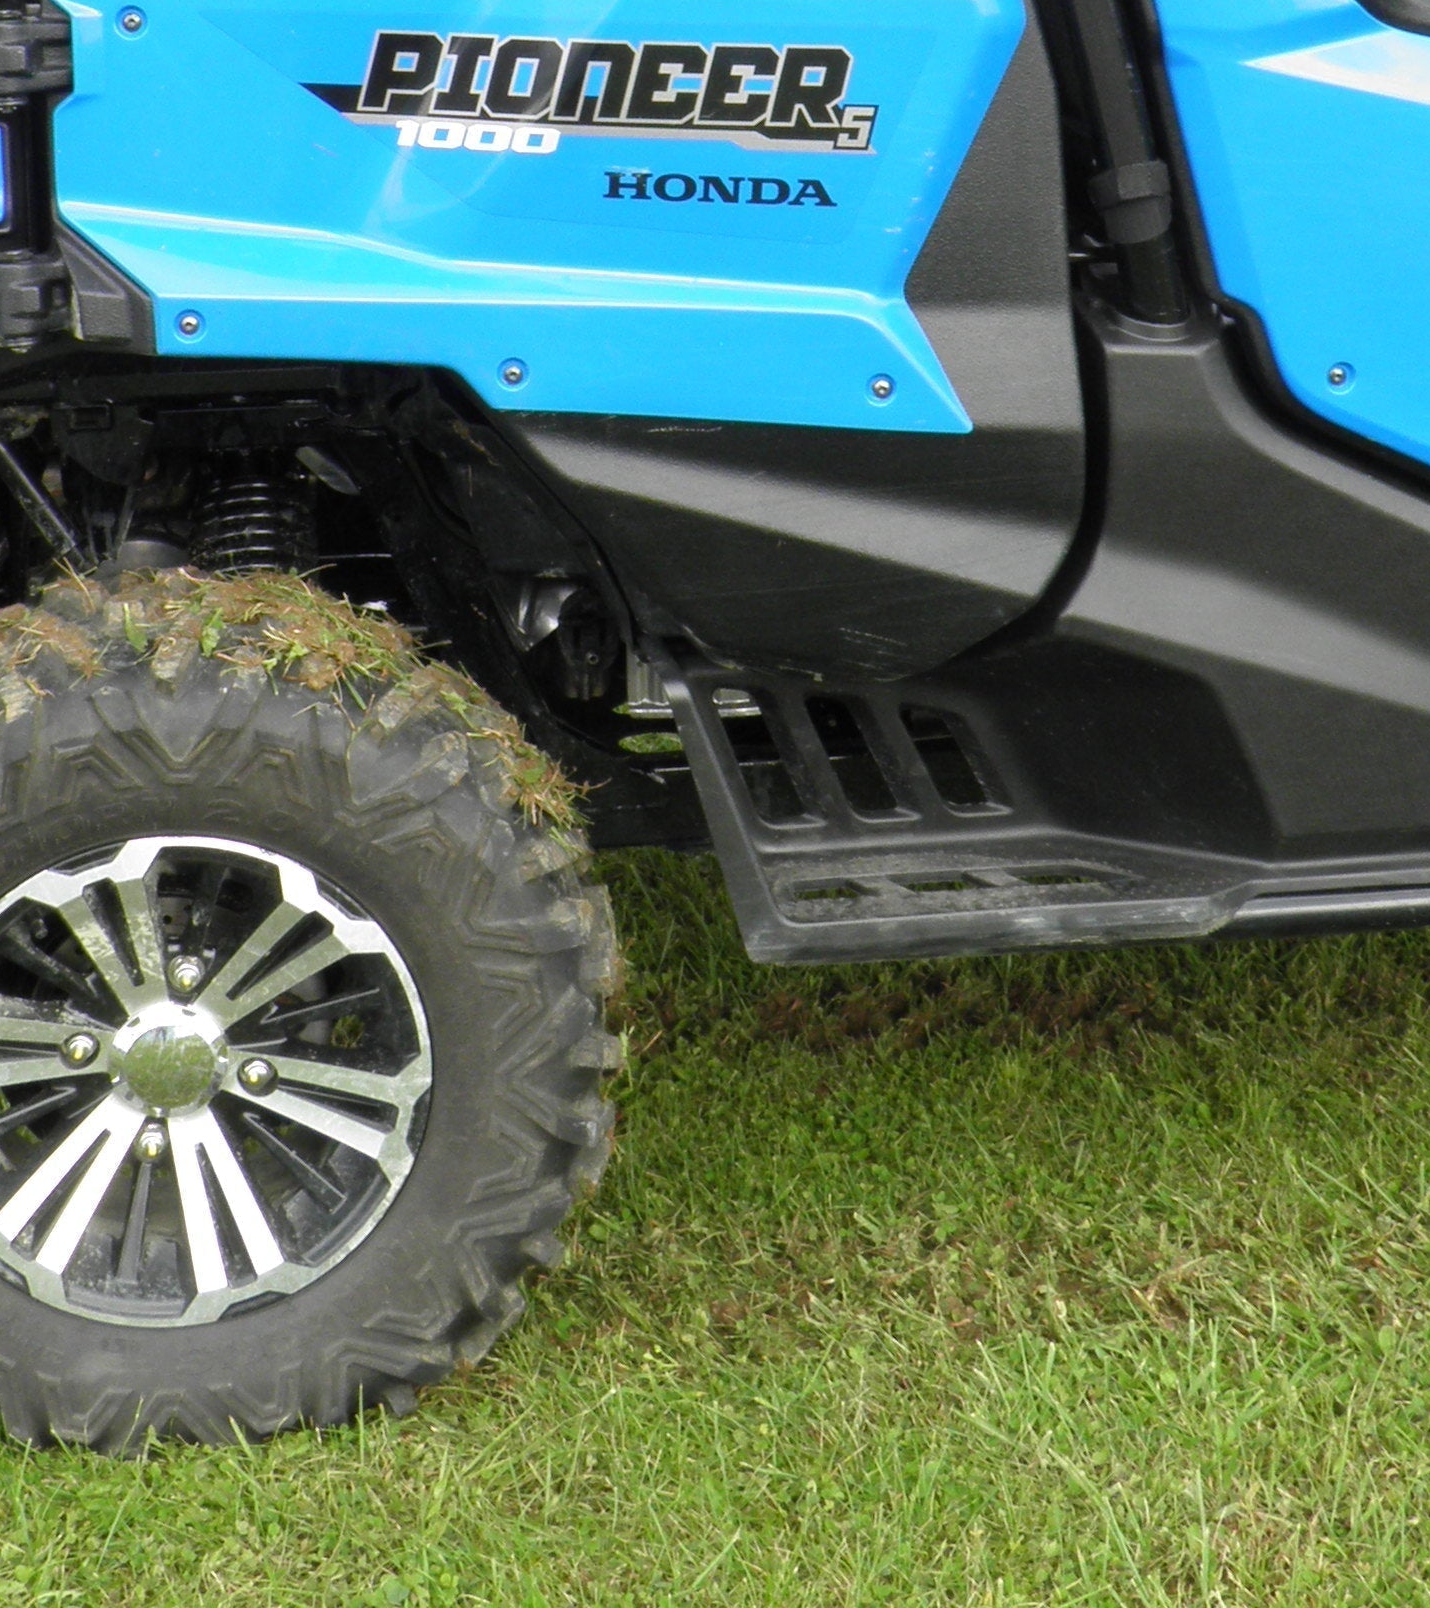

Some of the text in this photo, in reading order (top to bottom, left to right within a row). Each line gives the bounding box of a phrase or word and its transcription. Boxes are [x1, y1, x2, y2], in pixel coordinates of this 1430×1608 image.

[357, 29, 855, 128] PIONEER
[396, 120, 561, 154] 1000
[603, 170, 837, 208] HONDA
